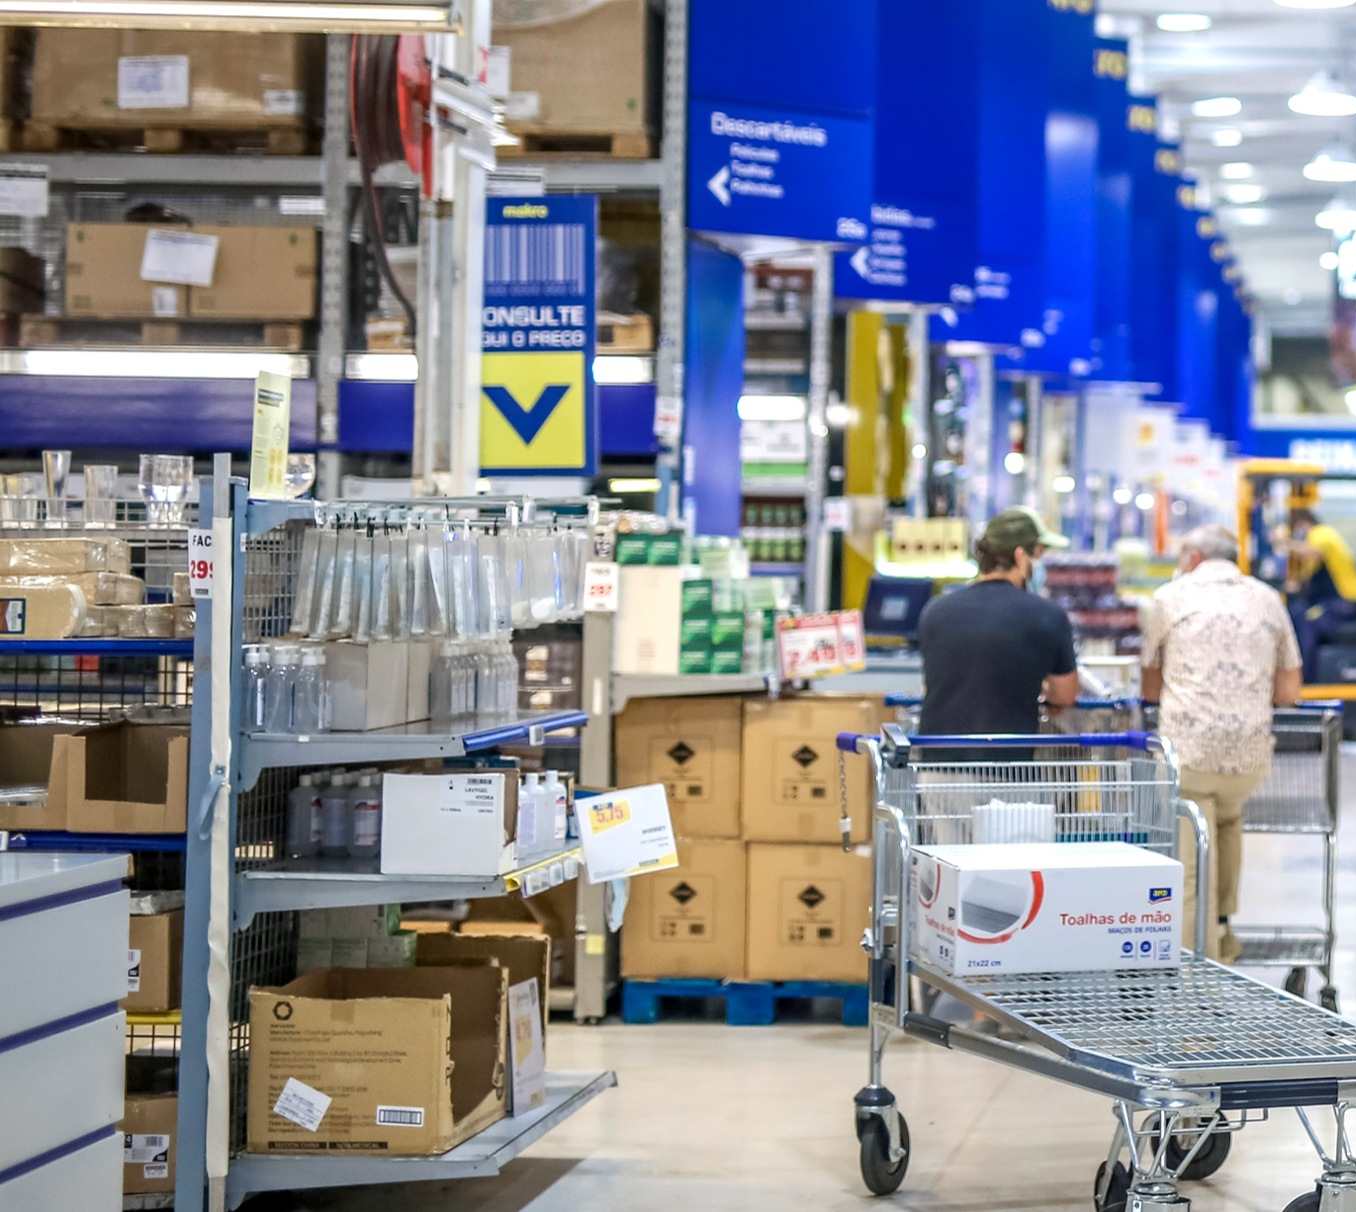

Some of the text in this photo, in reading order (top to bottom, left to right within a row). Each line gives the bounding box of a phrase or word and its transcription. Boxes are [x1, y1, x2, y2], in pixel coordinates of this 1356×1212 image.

[711, 112, 827, 147] Descartáveis
[503, 203, 548, 218] makro
[482, 305, 585, 327] ONSULTE
[482, 330, 509, 348] QUI
[529, 329, 586, 349] PREÇO
[597, 806, 624, 824] 5,75
[1060, 910, 1172, 926] Toalhas de mão
[1107, 925, 1172, 935] MAÇOS DE FOLHAS
[967, 959, 990, 967] 21x22
